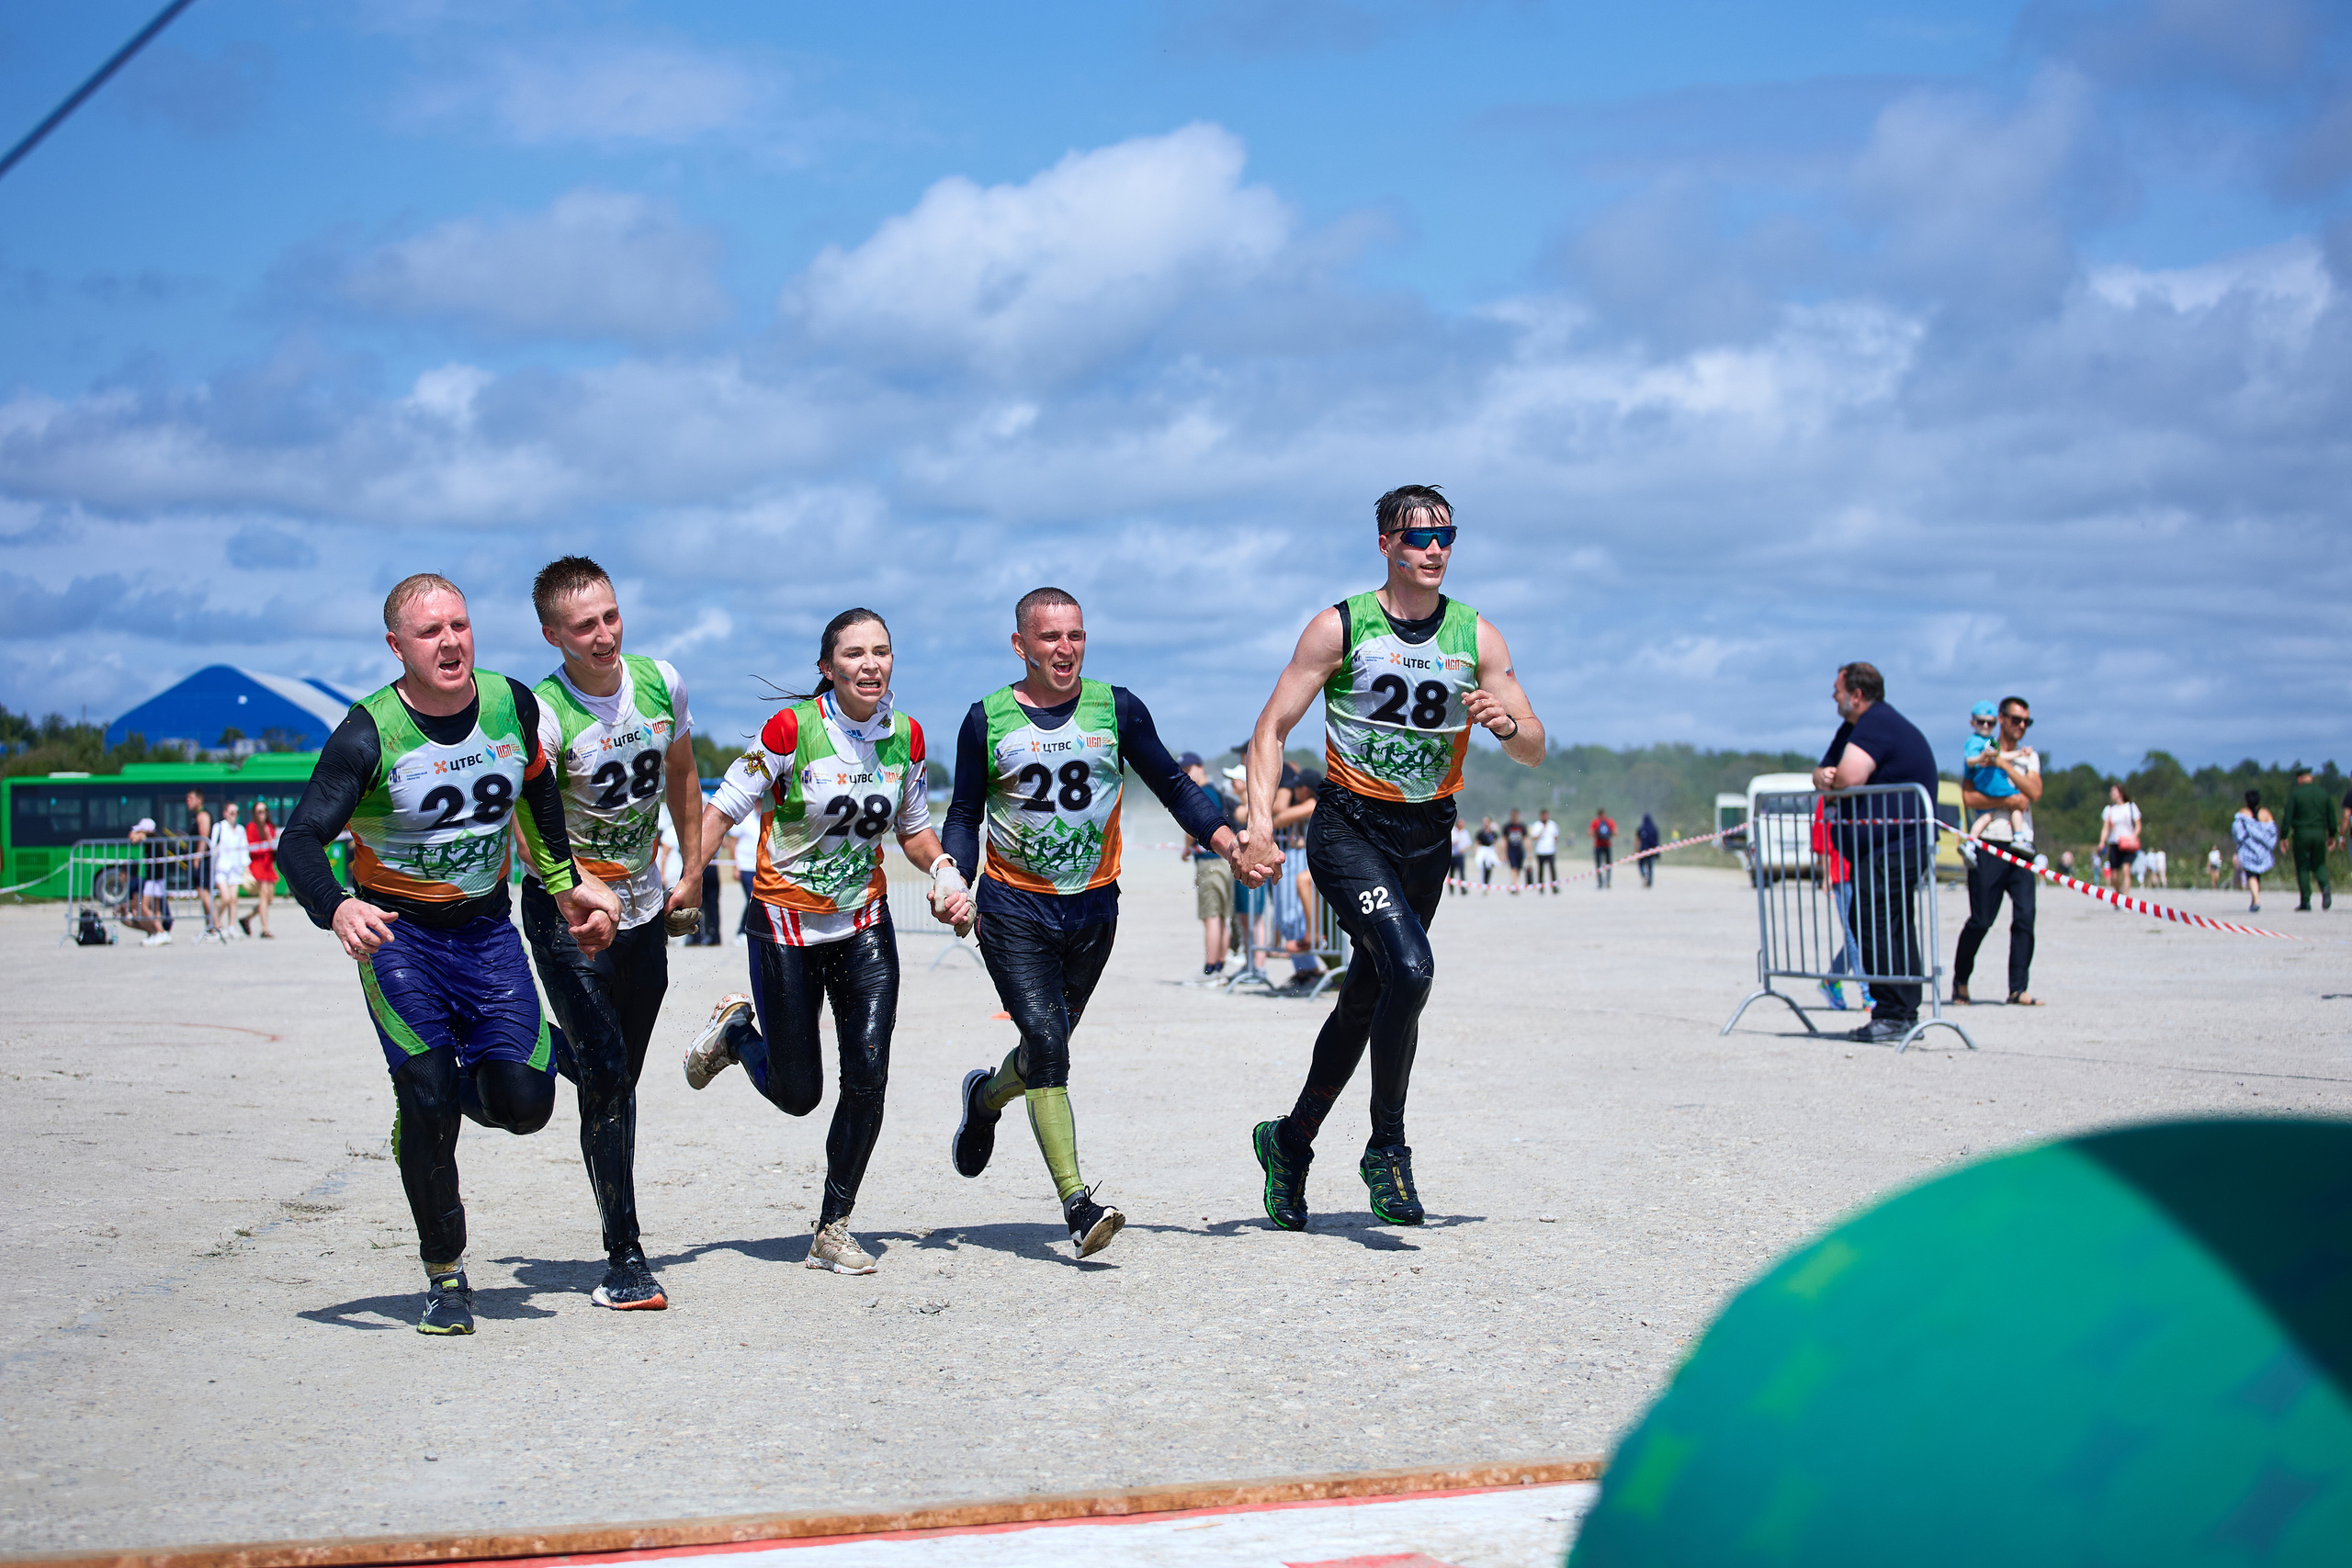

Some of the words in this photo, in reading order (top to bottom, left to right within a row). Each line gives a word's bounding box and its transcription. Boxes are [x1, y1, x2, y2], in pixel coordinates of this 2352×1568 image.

[1403, 657, 1430, 670] ЦТВС
[1365, 672, 1449, 729] 28
[450, 753, 483, 771] ЦТВС
[1043, 741, 1071, 753] ЦТВС
[588, 749, 662, 809] 28
[849, 773, 873, 784] ЦТВС
[1018, 759, 1093, 813] 28
[419, 773, 514, 830] 28
[824, 794, 892, 840] 28
[1358, 886, 1391, 915] 32
